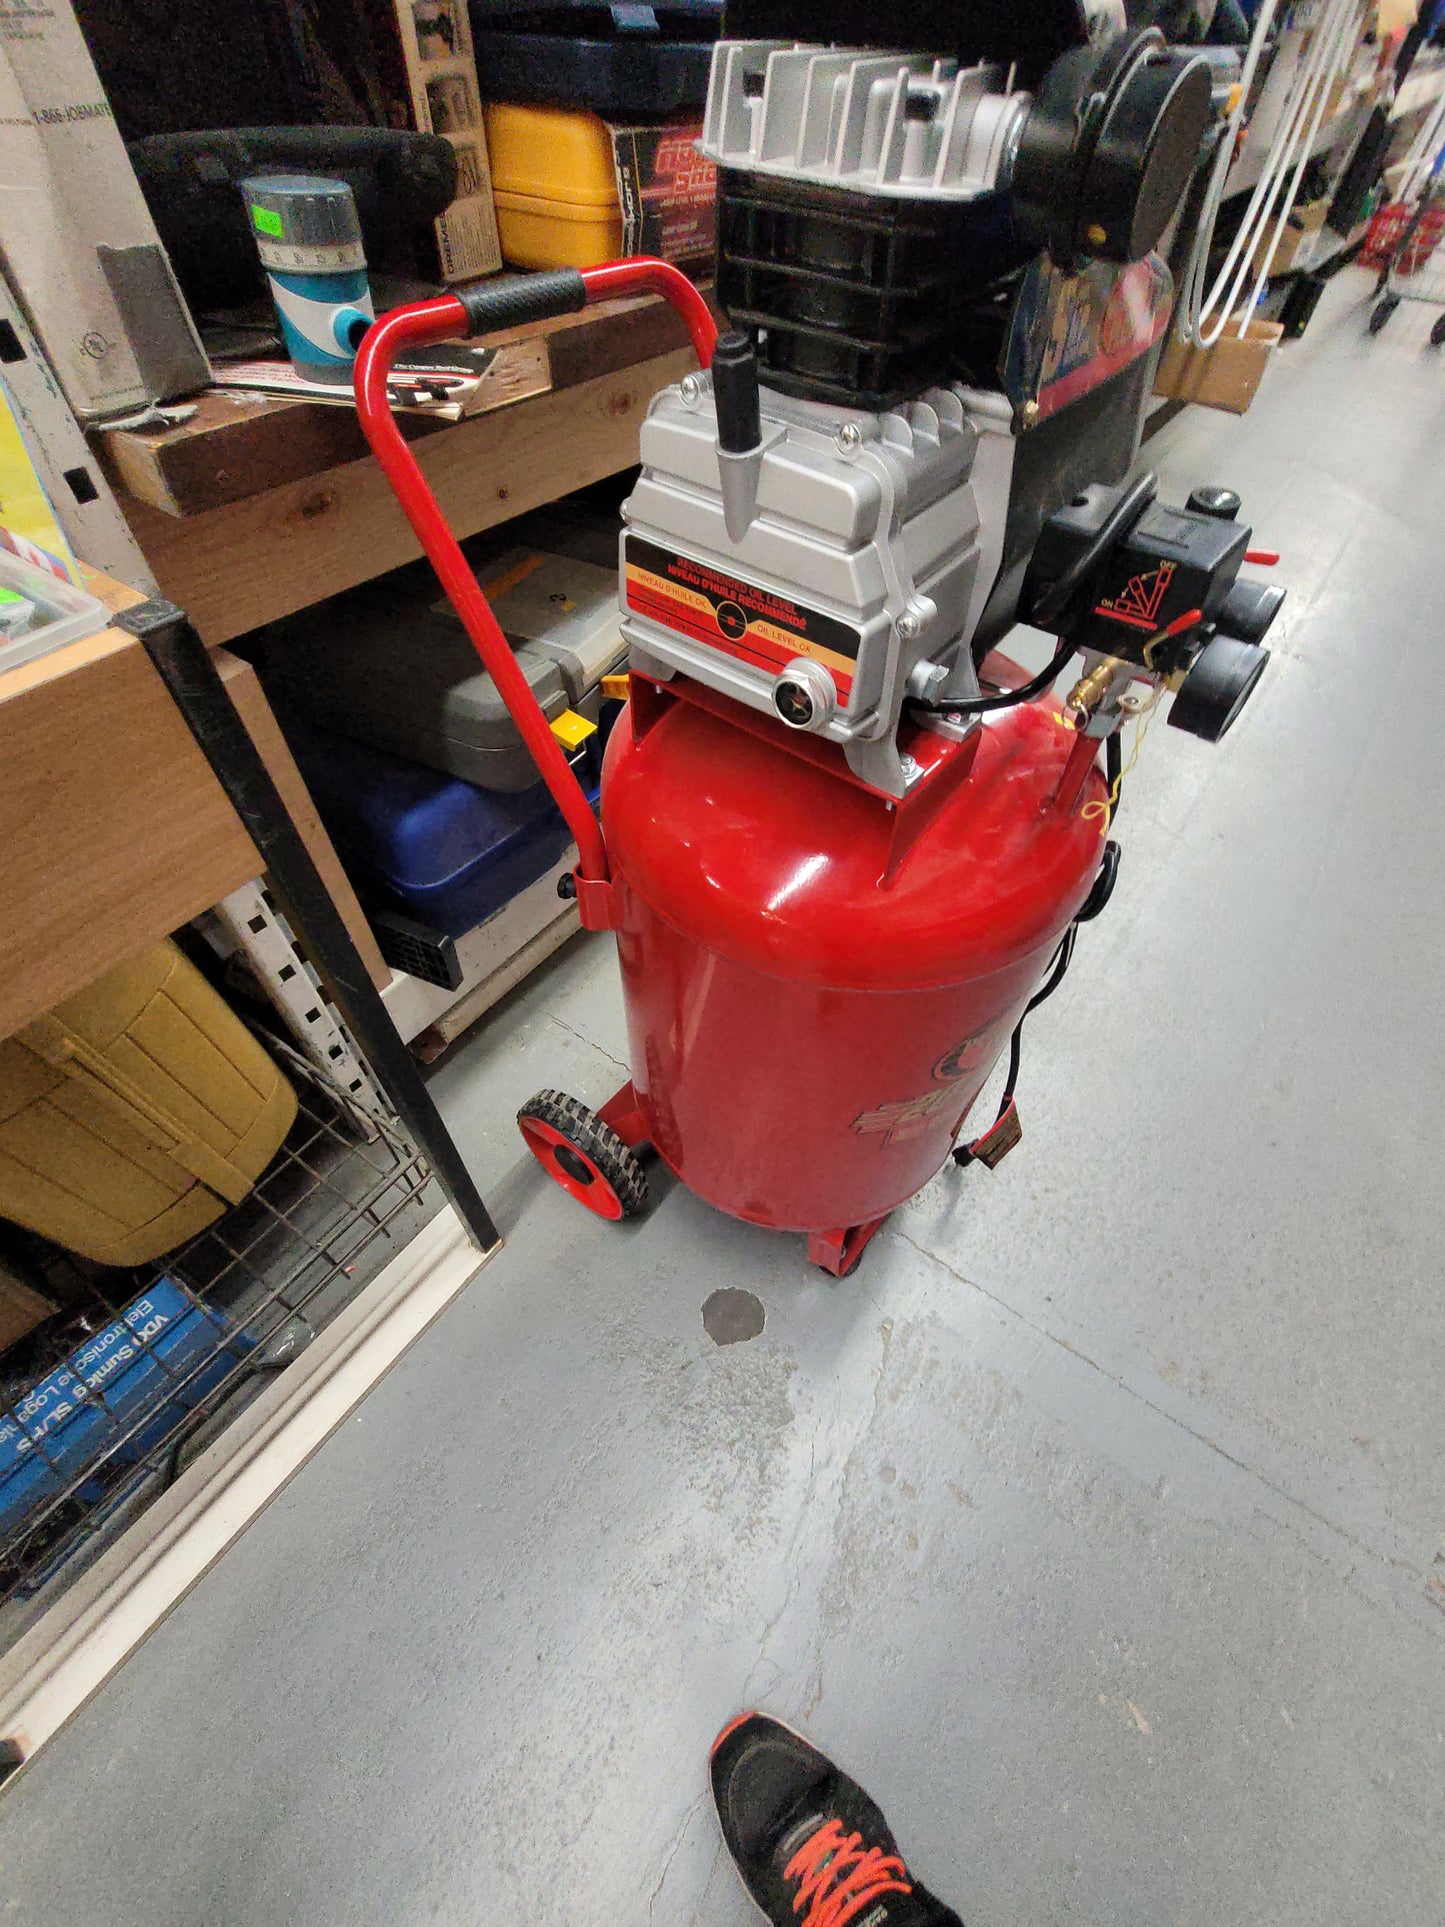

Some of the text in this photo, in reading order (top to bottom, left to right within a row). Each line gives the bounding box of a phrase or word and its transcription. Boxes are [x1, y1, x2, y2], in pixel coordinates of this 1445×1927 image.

[1160, 560, 1177, 569] OFF
[637, 572, 664, 590] NIVEAU
[665, 583, 694, 603] D'HUILE
[695, 596, 707, 609] OK
[667, 564, 700, 586] NIVEAU
[701, 577, 737, 601] D'HUILE
[738, 591, 807, 630] RECOMMENDÉ
[677, 556, 797, 616] RECOMMENDED OIL LEVEL
[1101, 599, 1113, 608] ON
[757, 624, 812, 654] OIL LEVEL OK
[132, 1314, 170, 1347] VDO
[73, 1343, 136, 1400] Sumlog
